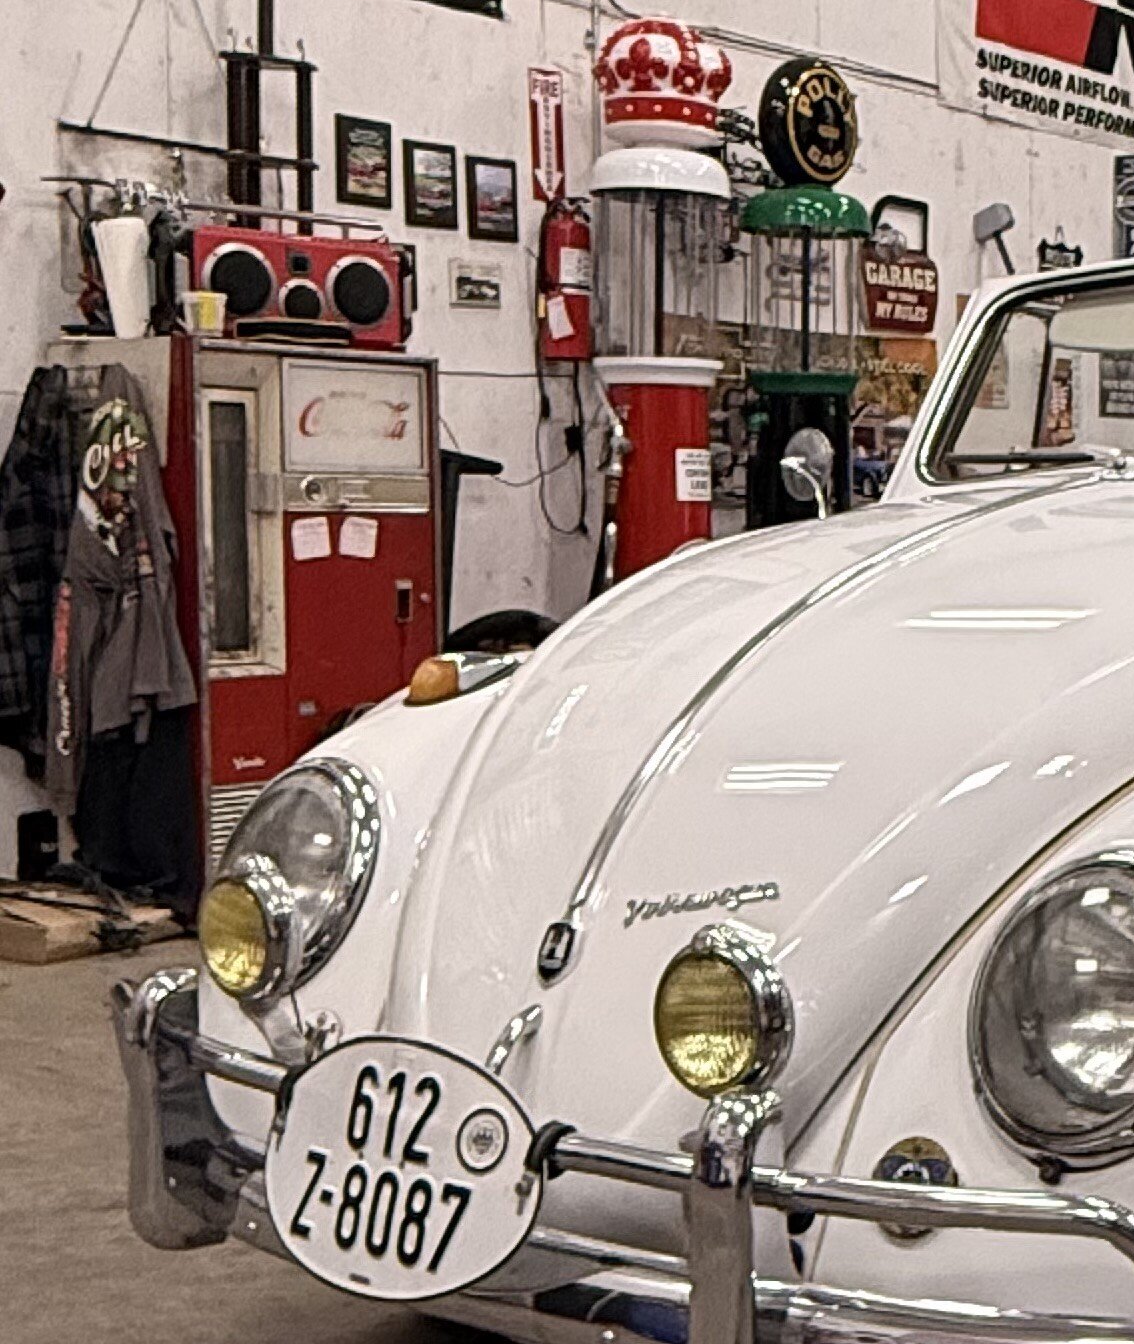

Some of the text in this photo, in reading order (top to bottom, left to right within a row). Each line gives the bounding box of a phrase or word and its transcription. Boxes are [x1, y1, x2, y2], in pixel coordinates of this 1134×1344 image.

[531, 77, 559, 98] FIRE
[975, 47, 1063, 91] SUPERIOR
[977, 76, 1061, 119] SUPERIOR
[806, 143, 845, 169] GAS
[864, 259, 936, 293] GARAGE
[347, 1064, 441, 1166] 612
[290, 1150, 472, 1274] Z-8087
